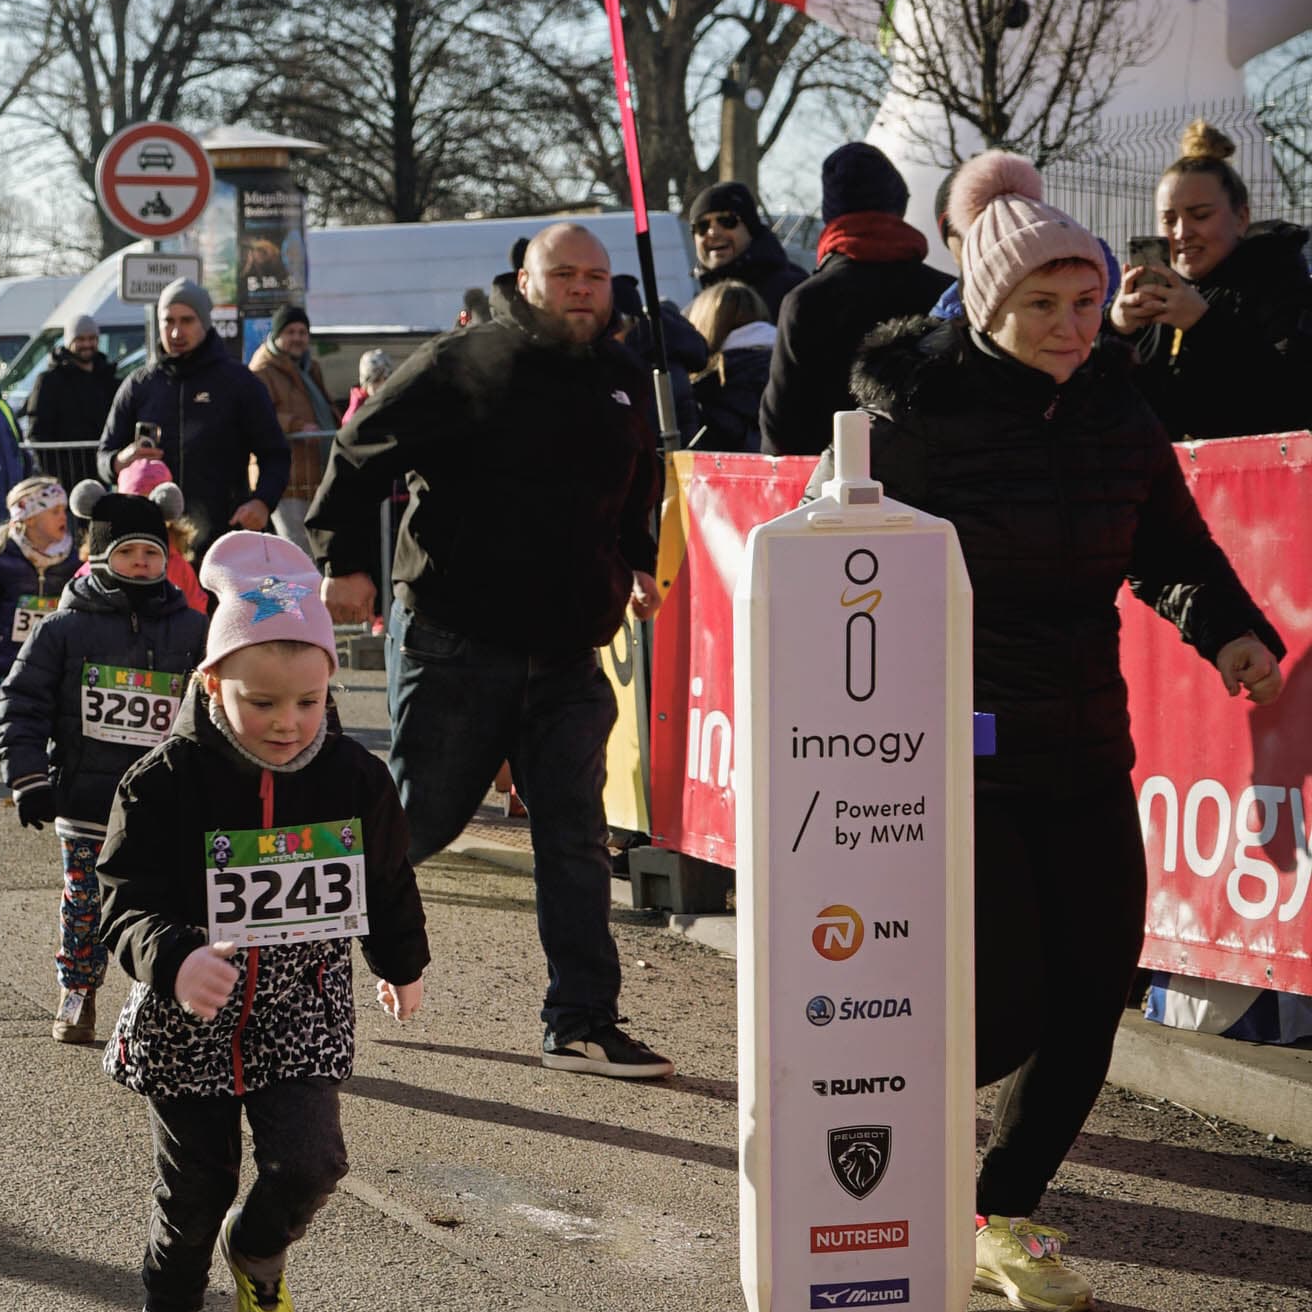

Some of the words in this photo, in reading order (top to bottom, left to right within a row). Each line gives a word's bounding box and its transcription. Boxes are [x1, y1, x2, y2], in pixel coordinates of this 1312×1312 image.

[85, 689, 172, 731] 3298
[791, 726, 925, 763] innogy
[835, 795, 926, 819] Powered
[835, 826, 861, 850] by
[870, 823, 924, 844] MVM
[1138, 775, 1312, 922] nogy
[214, 862, 353, 924] 3243
[873, 919, 909, 939] NN
[838, 996, 912, 1021] ŠKODA
[830, 1075, 906, 1096] RUNTO
[833, 1130, 886, 1142] PEUGEOT
[815, 1229, 905, 1249] NUTREND
